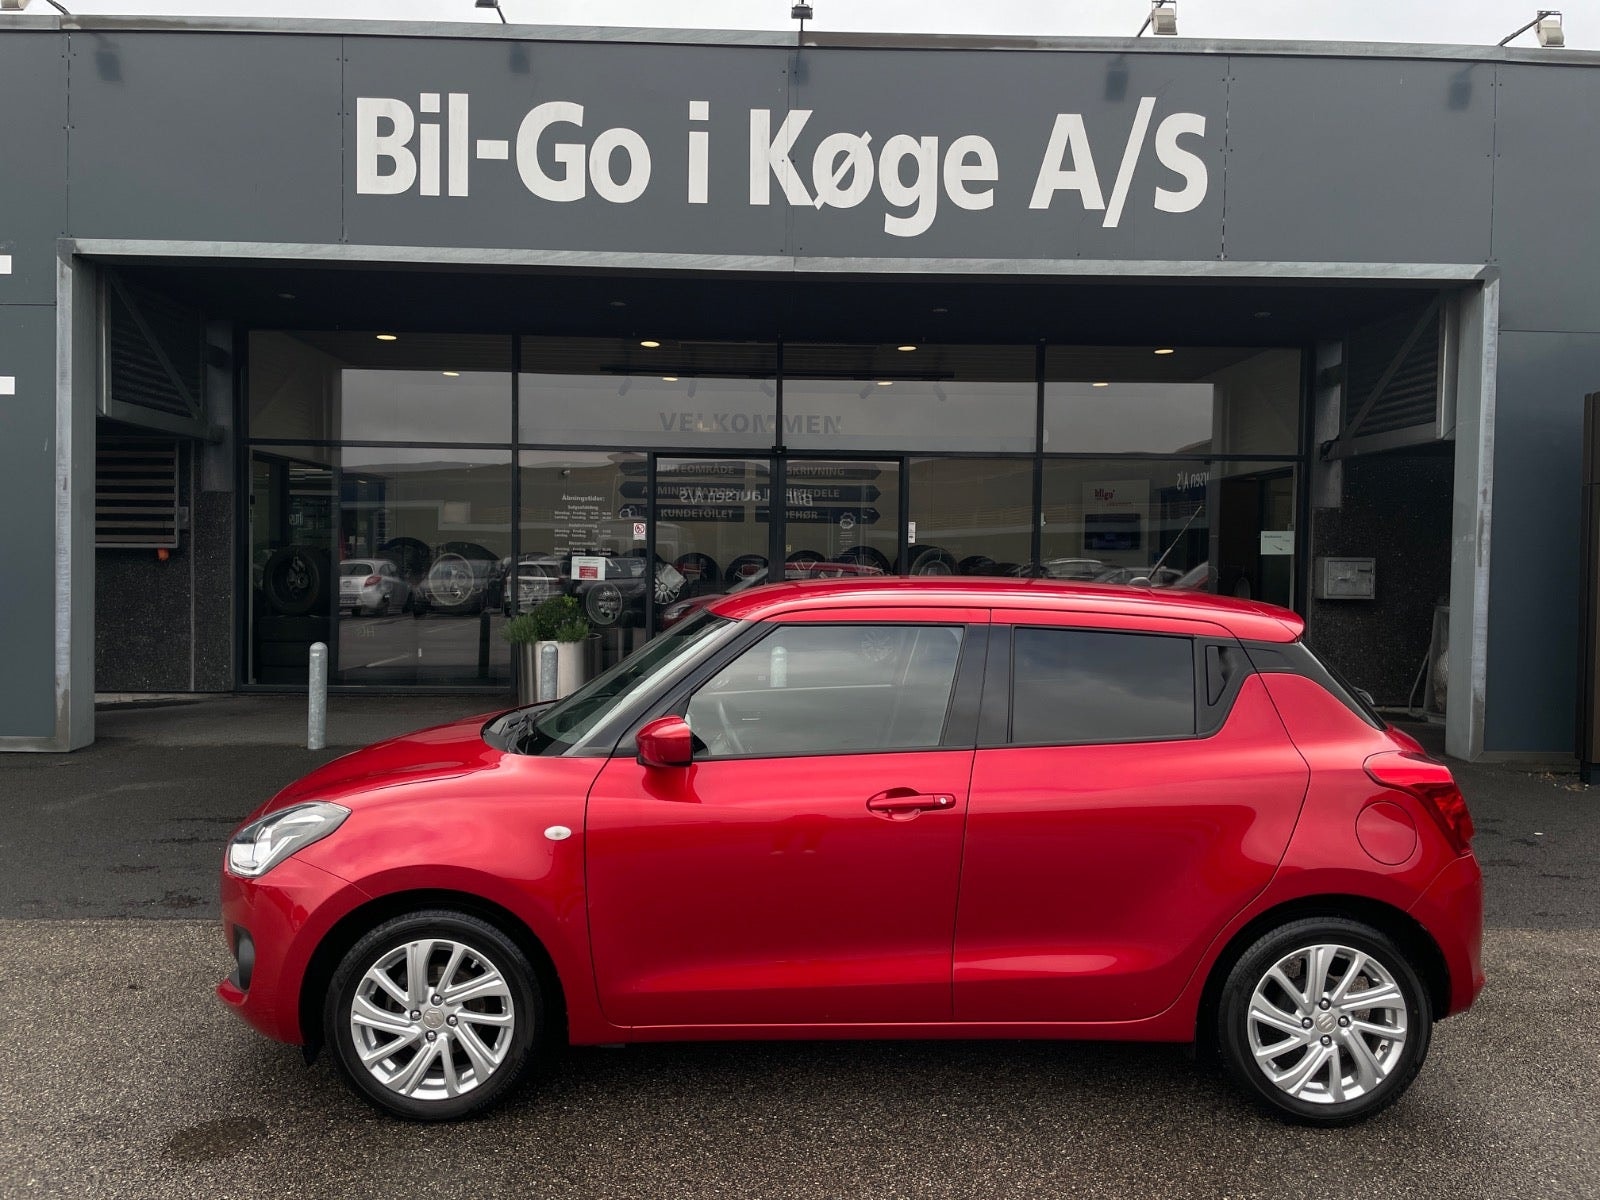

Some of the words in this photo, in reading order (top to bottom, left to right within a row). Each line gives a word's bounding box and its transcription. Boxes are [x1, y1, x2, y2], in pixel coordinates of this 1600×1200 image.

[357, 92, 651, 203] Bil-Go
[688, 101, 709, 203] i
[750, 108, 998, 237] Køge
[1028, 97, 1208, 227] A/S
[659, 412, 842, 434] VELKOMMEN
[661, 508, 733, 518] KUNDETOILET
